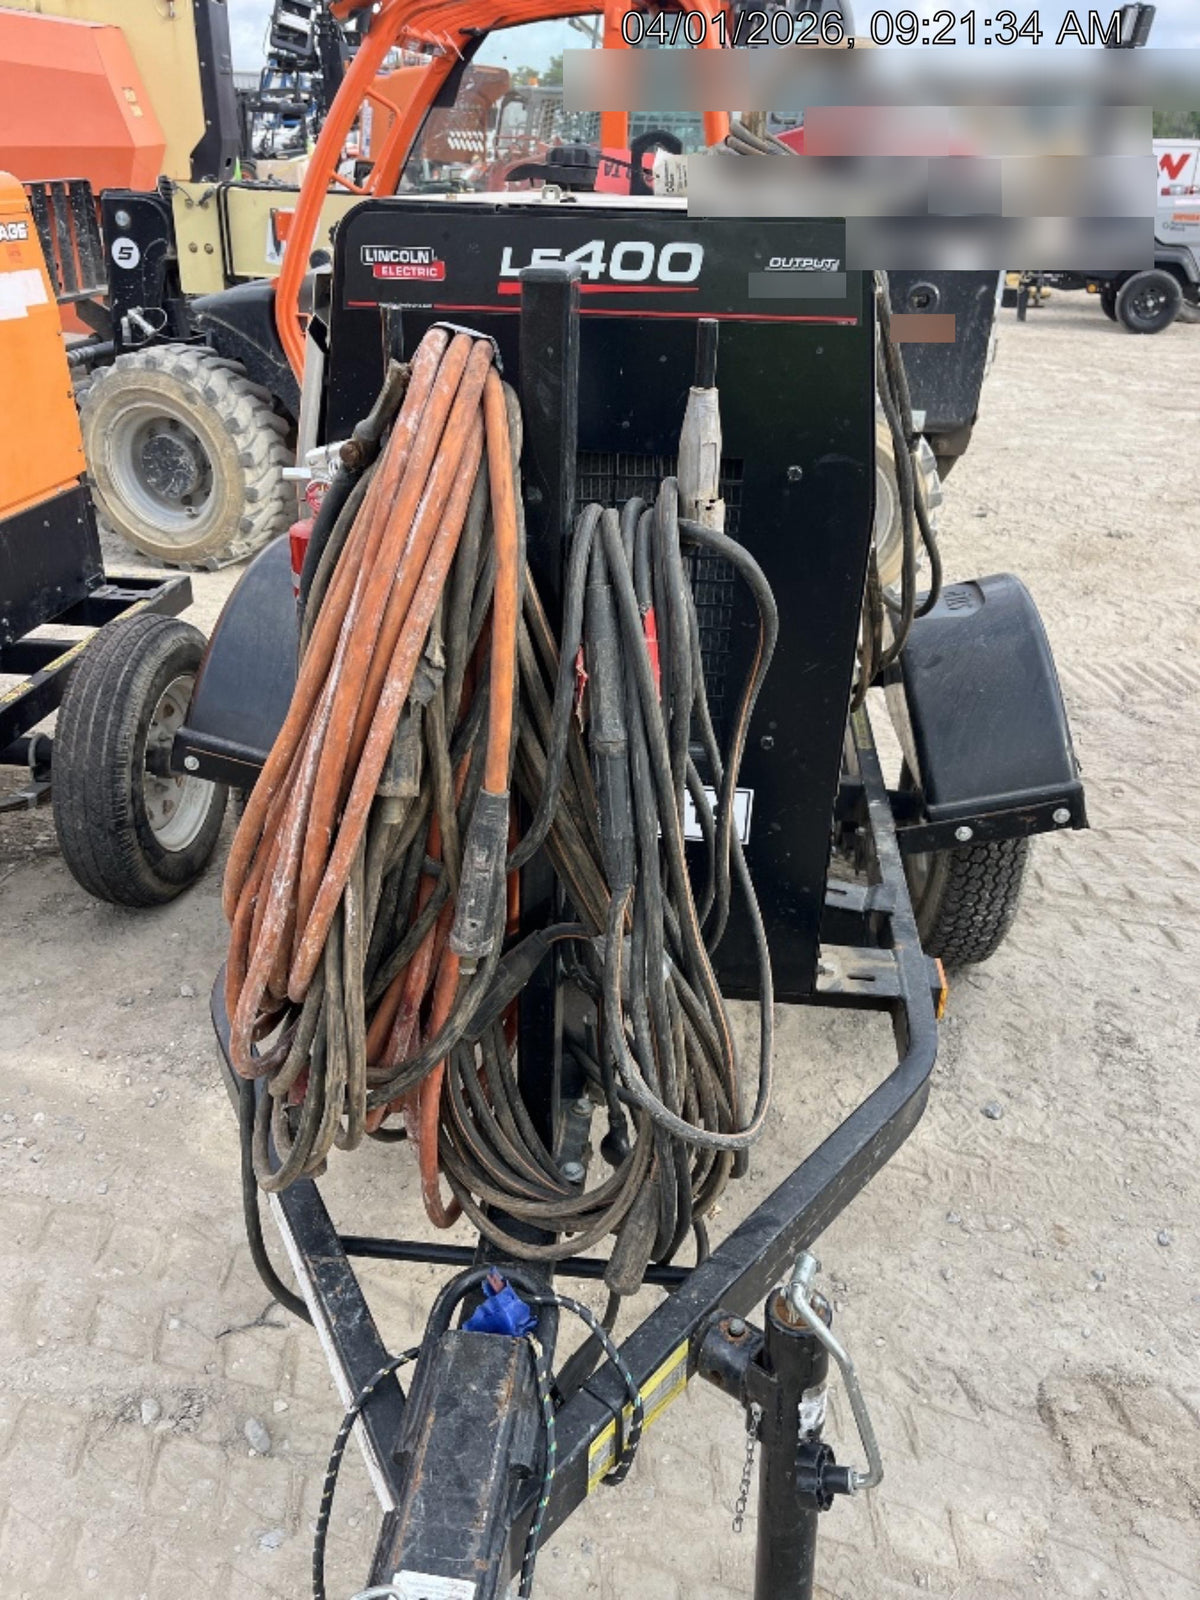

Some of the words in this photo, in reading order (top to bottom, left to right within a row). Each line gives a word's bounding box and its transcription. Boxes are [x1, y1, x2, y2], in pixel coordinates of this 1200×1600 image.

[364, 248, 430, 264] LINCOLN
[768, 257, 836, 269] OUTPUT
[380, 265, 438, 278] ELECTRIC
